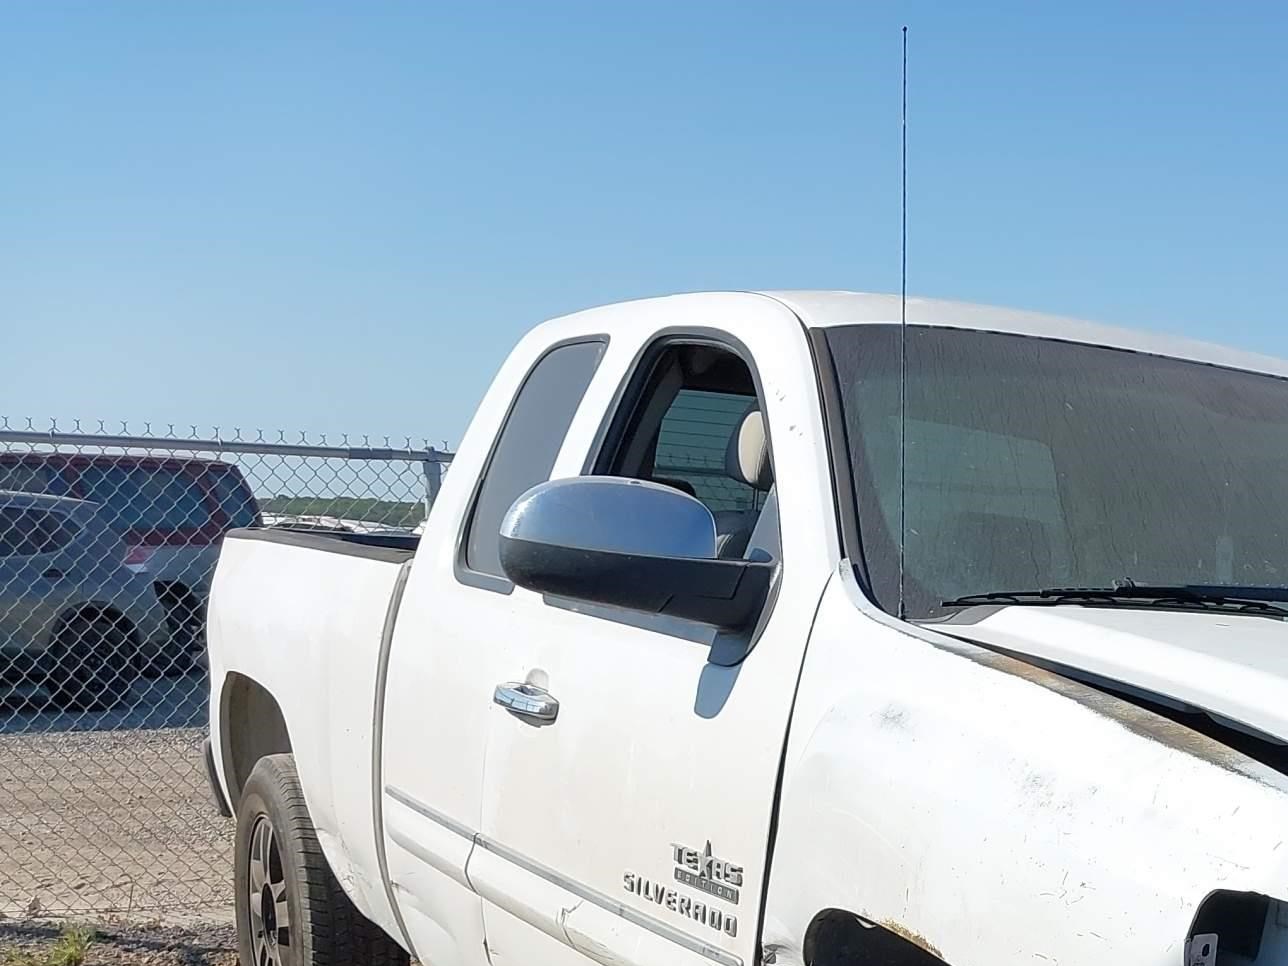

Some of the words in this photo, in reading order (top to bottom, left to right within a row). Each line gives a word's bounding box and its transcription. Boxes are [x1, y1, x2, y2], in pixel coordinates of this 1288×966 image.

[670, 840, 743, 887] TEXAS
[676, 870, 735, 900] EDITION
[623, 871, 738, 938] SILVERADO
